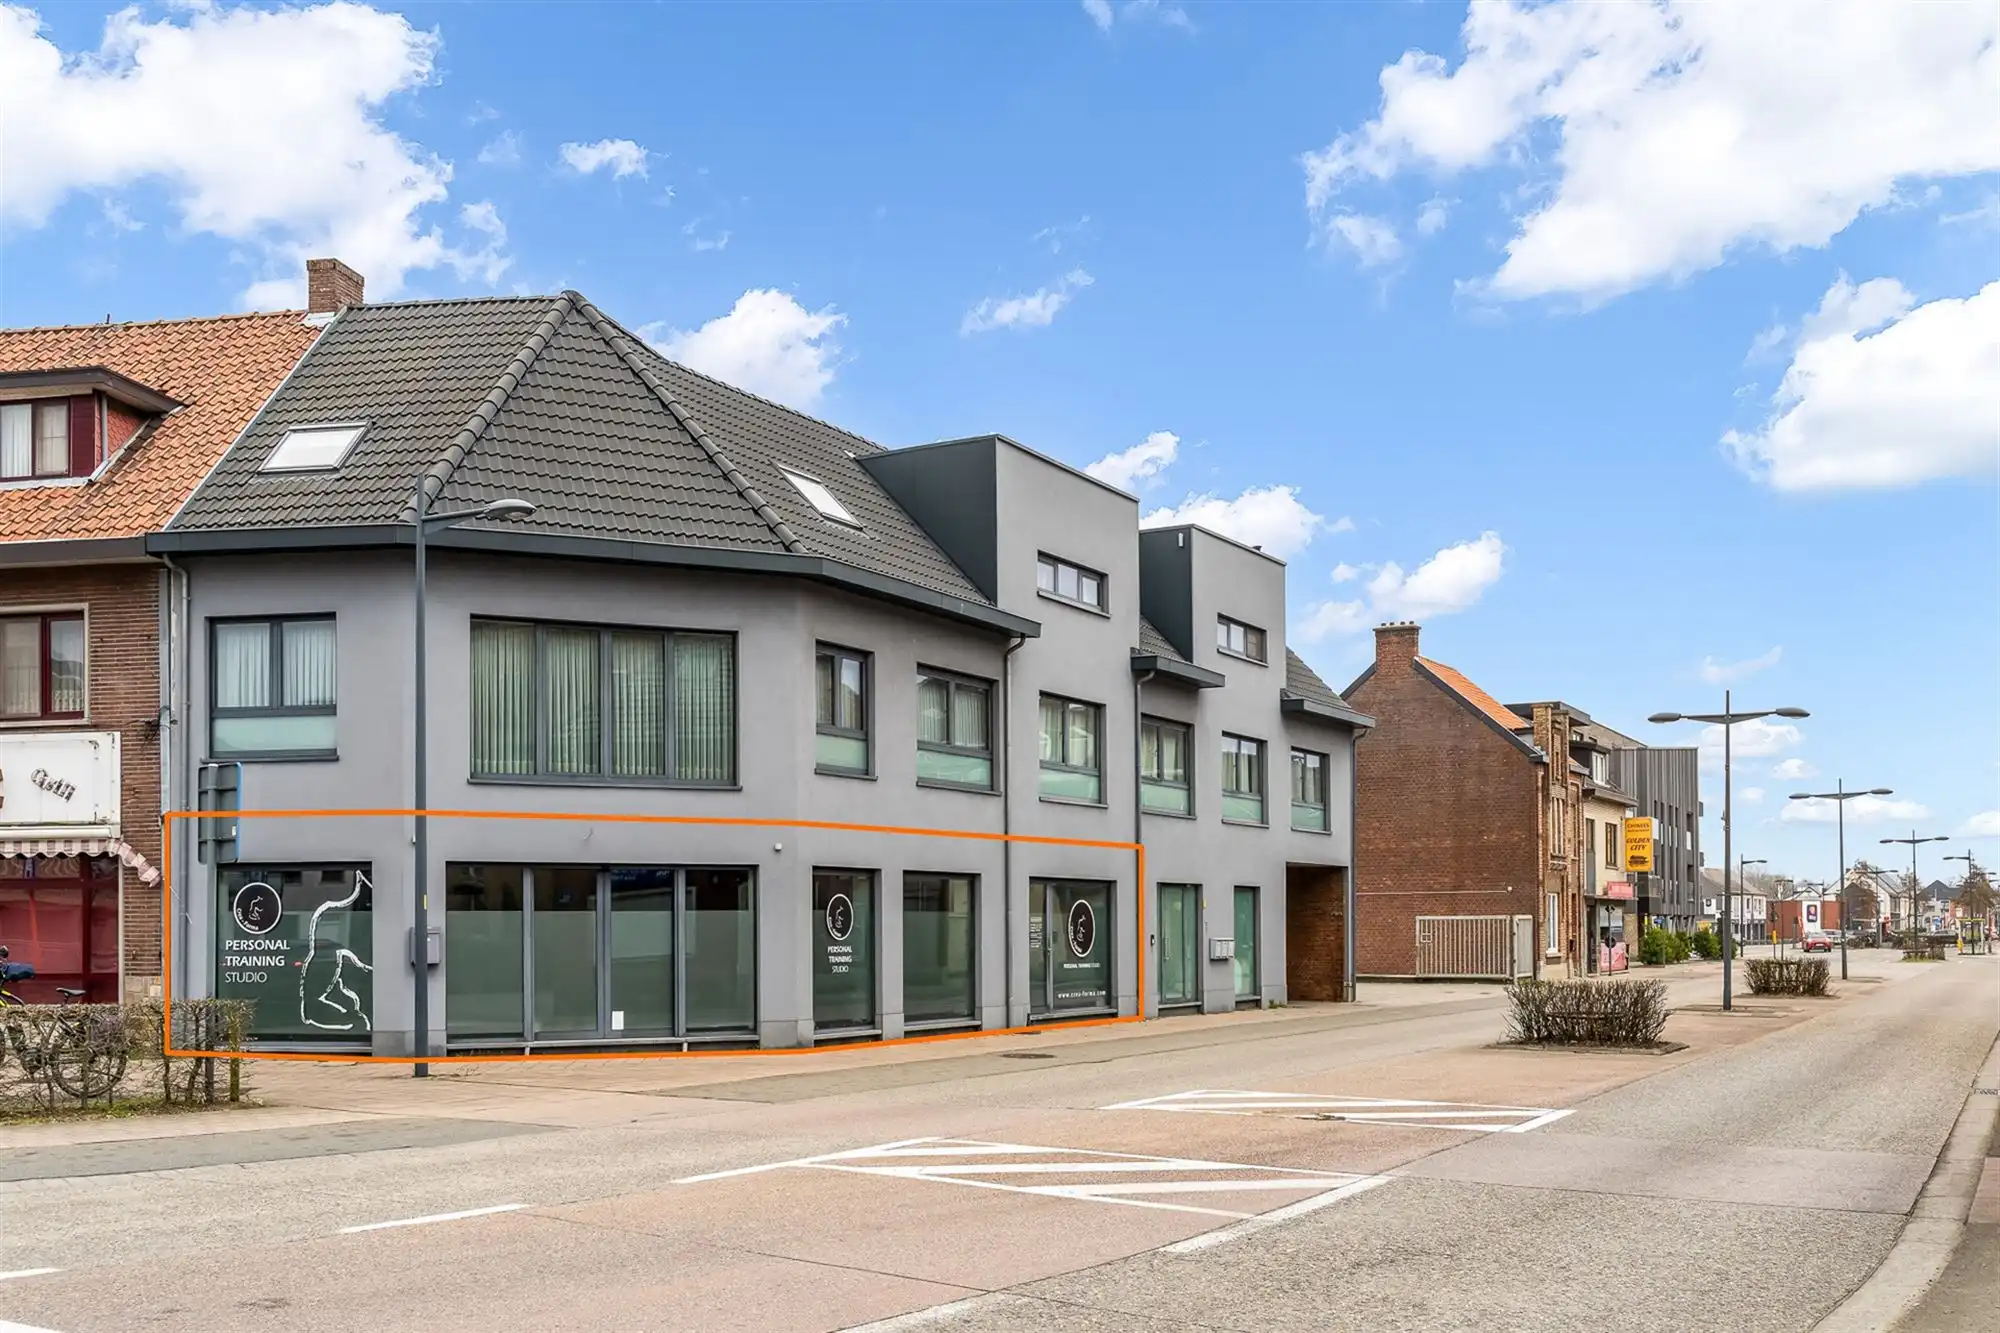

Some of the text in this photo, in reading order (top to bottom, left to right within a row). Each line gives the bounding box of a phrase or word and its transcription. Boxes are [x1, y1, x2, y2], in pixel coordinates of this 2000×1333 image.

[225, 940, 290, 950] PERSONAL
[225, 956, 285, 967] TRAINING
[225, 971, 268, 983] STUDIO
